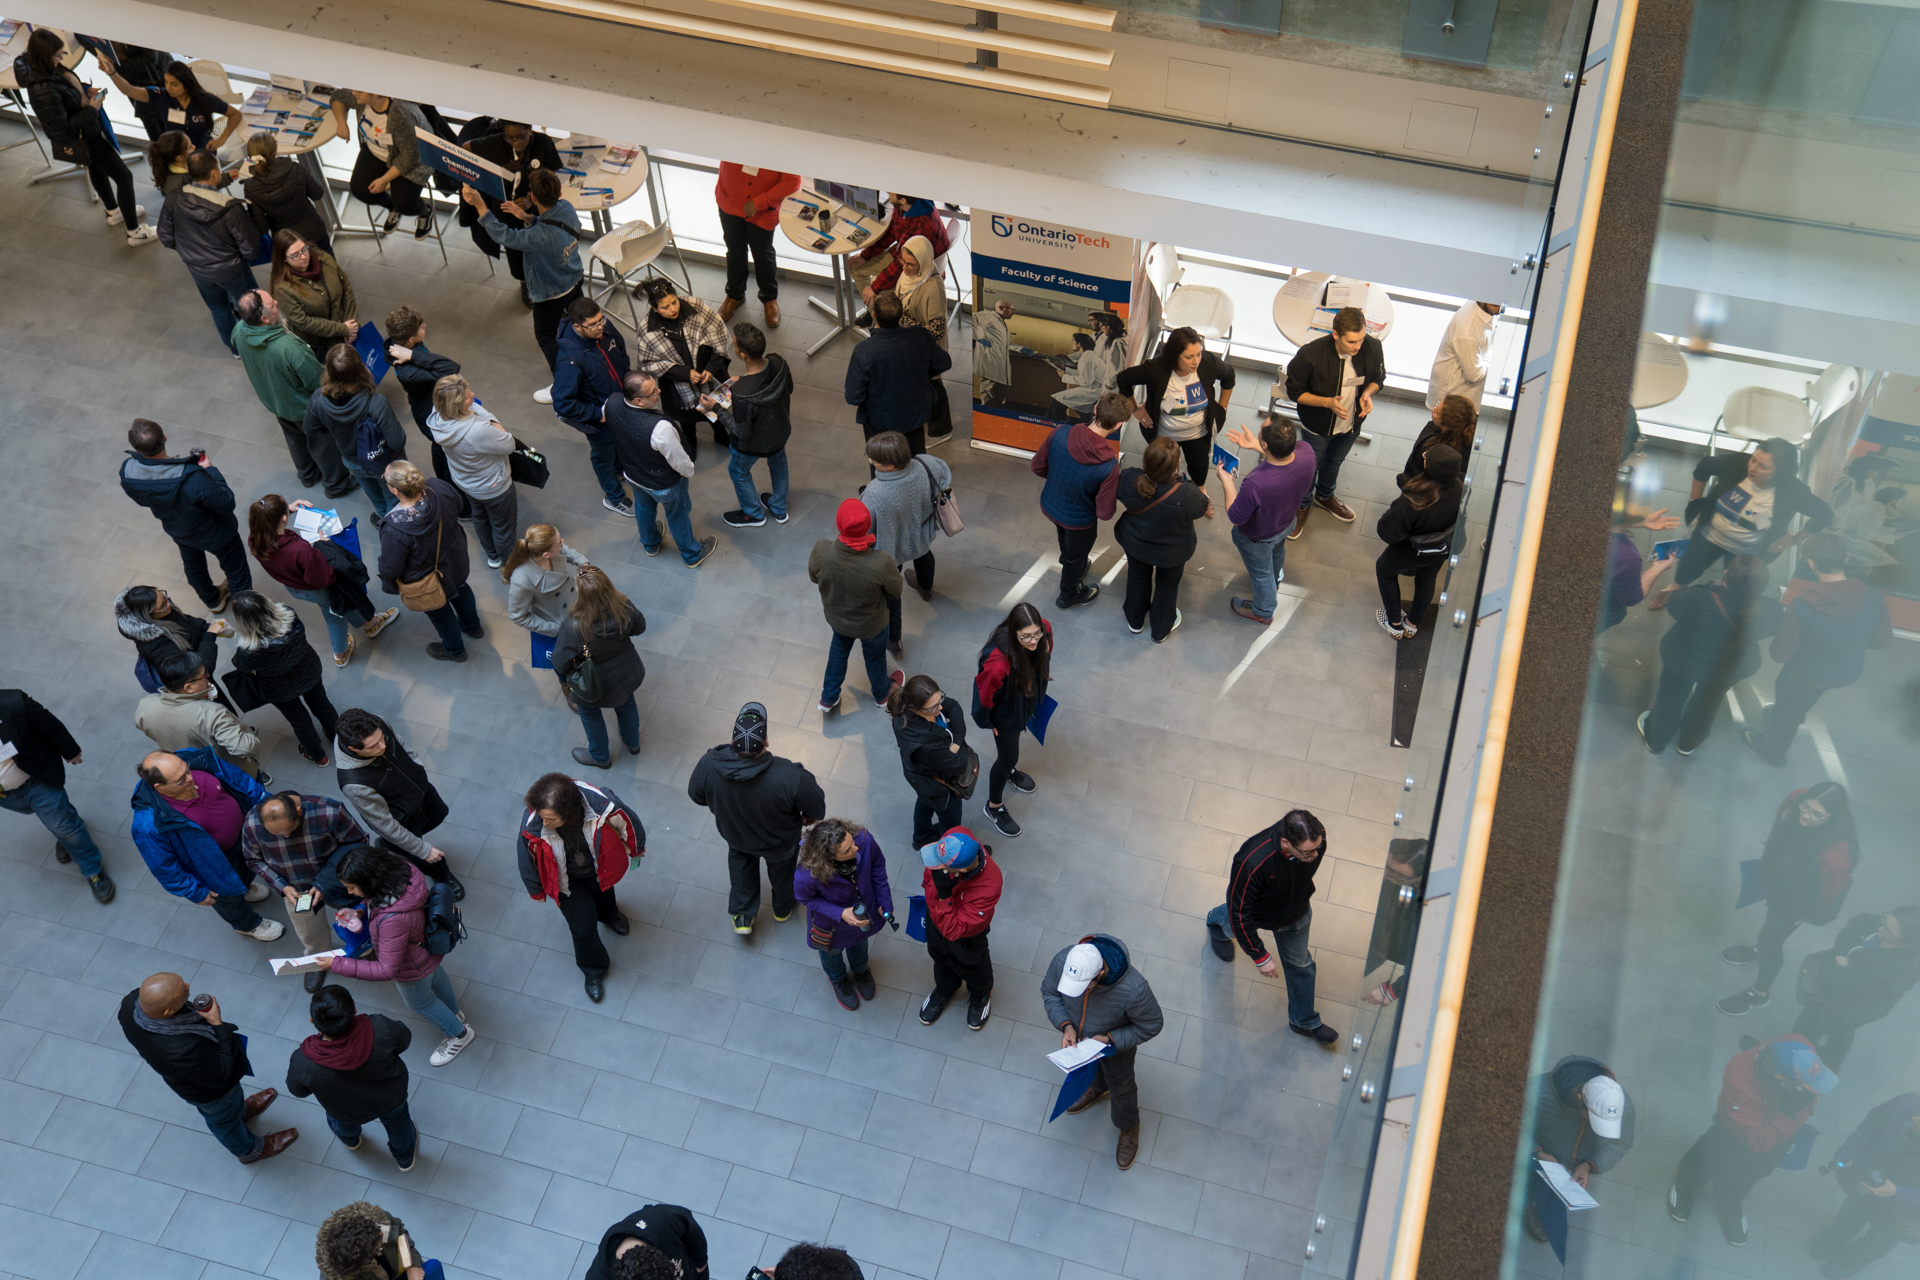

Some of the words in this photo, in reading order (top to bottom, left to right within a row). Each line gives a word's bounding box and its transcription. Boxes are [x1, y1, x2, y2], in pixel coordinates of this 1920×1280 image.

[438, 140, 456, 153] Open
[458, 150, 479, 163] House
[442, 155, 480, 179] Chemistry
[448, 164, 459, 175] lab
[460, 171, 476, 182] tour
[1018, 223, 1110, 249] OntarioTech
[1018, 235, 1075, 250] UNIVERSITY
[1001, 266, 1041, 282] Faculty
[1043, 275, 1056, 283] of
[1058, 276, 1099, 292] Science
[1191, 386, 1201, 398] W
